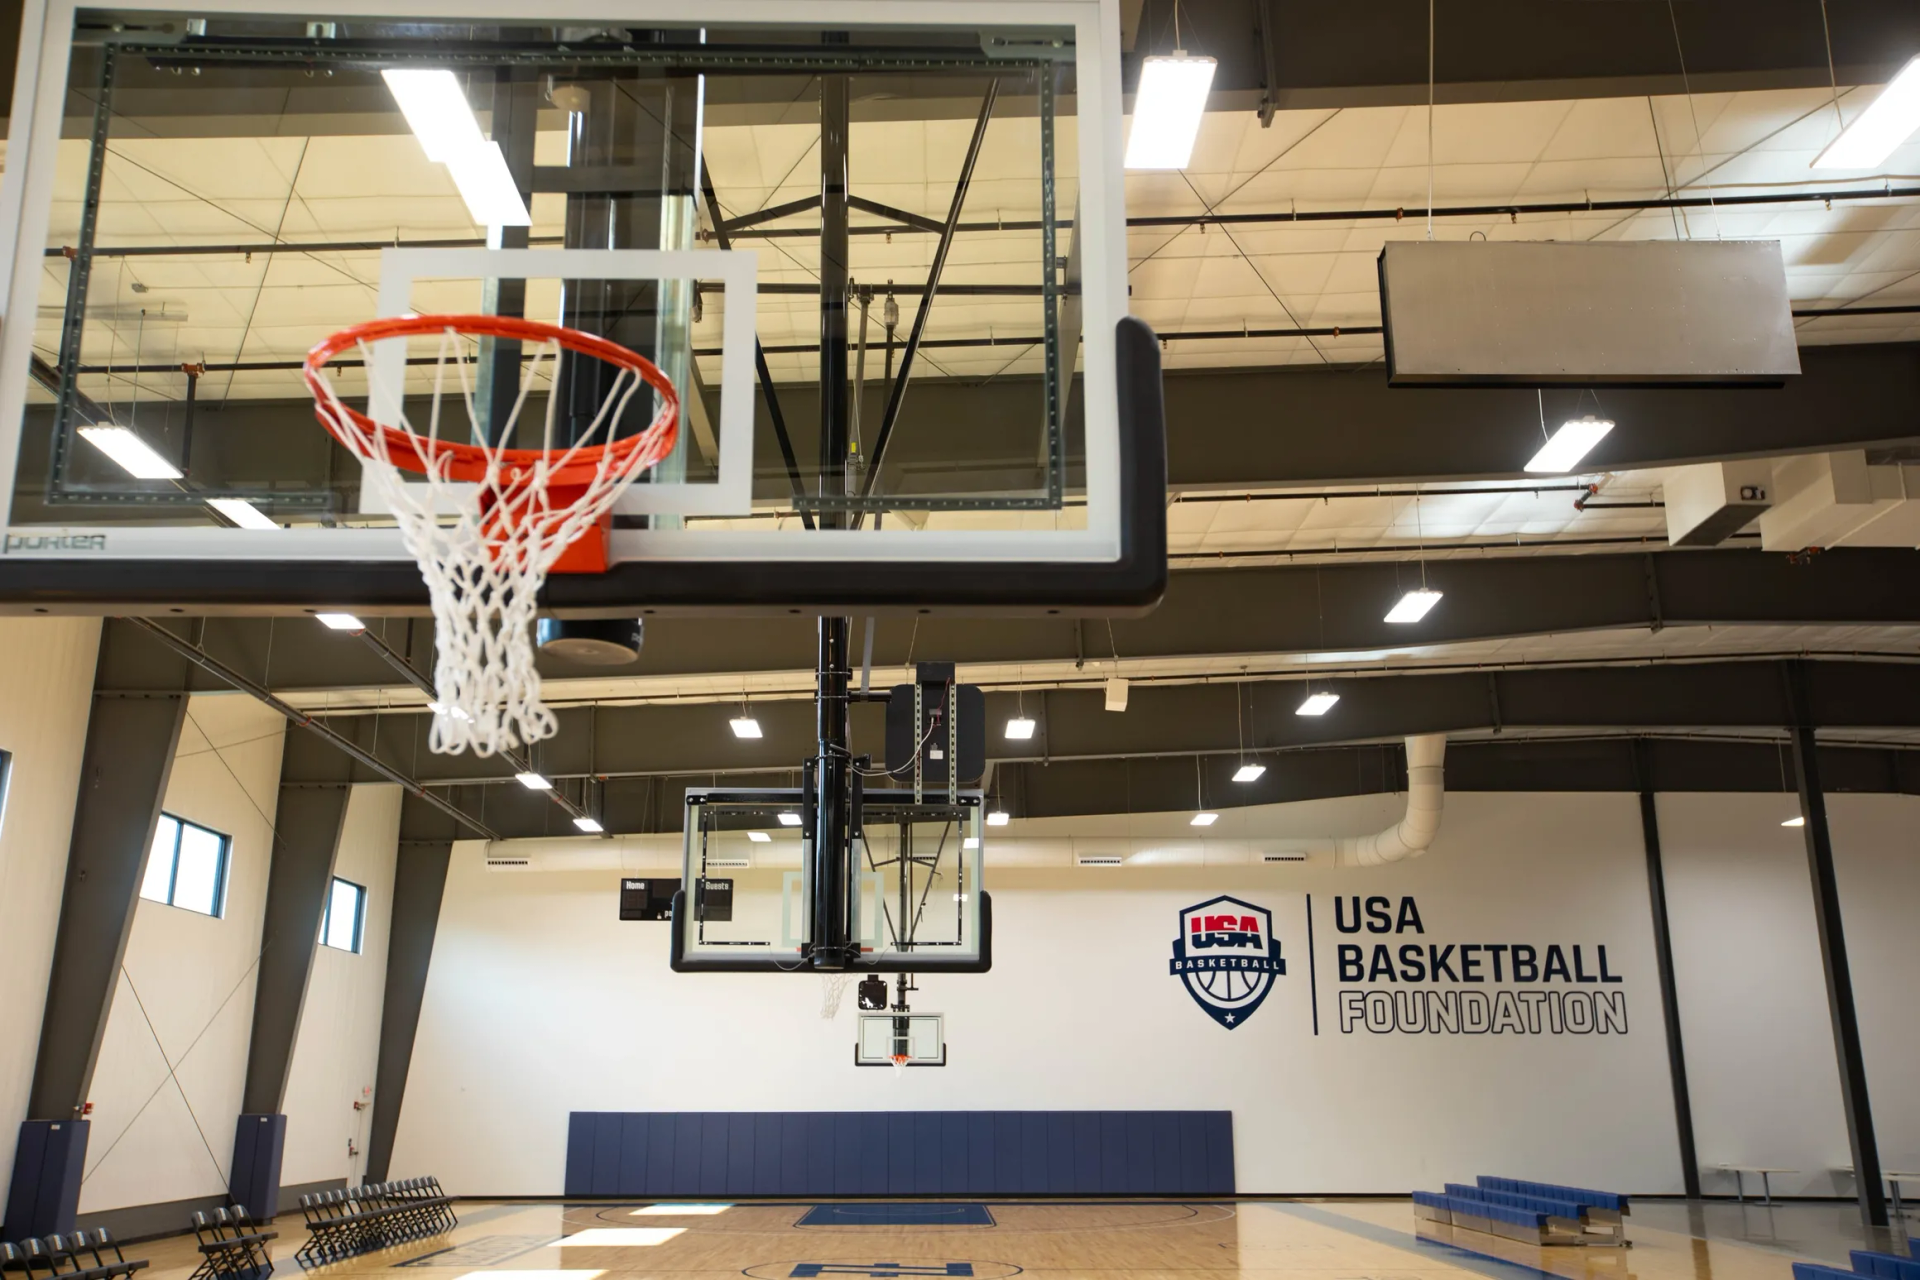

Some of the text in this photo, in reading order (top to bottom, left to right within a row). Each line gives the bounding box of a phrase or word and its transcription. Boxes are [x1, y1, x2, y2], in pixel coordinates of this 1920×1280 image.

[626, 881, 645, 890] Home
[705, 881, 729, 890] Guests
[1191, 915, 1263, 950] USA
[1334, 896, 1425, 934] USA
[1175, 959, 1279, 970] BASKETBALL
[1338, 944, 1623, 983] BASKETBALL
[1339, 990, 1628, 1035] FOUNDATION
